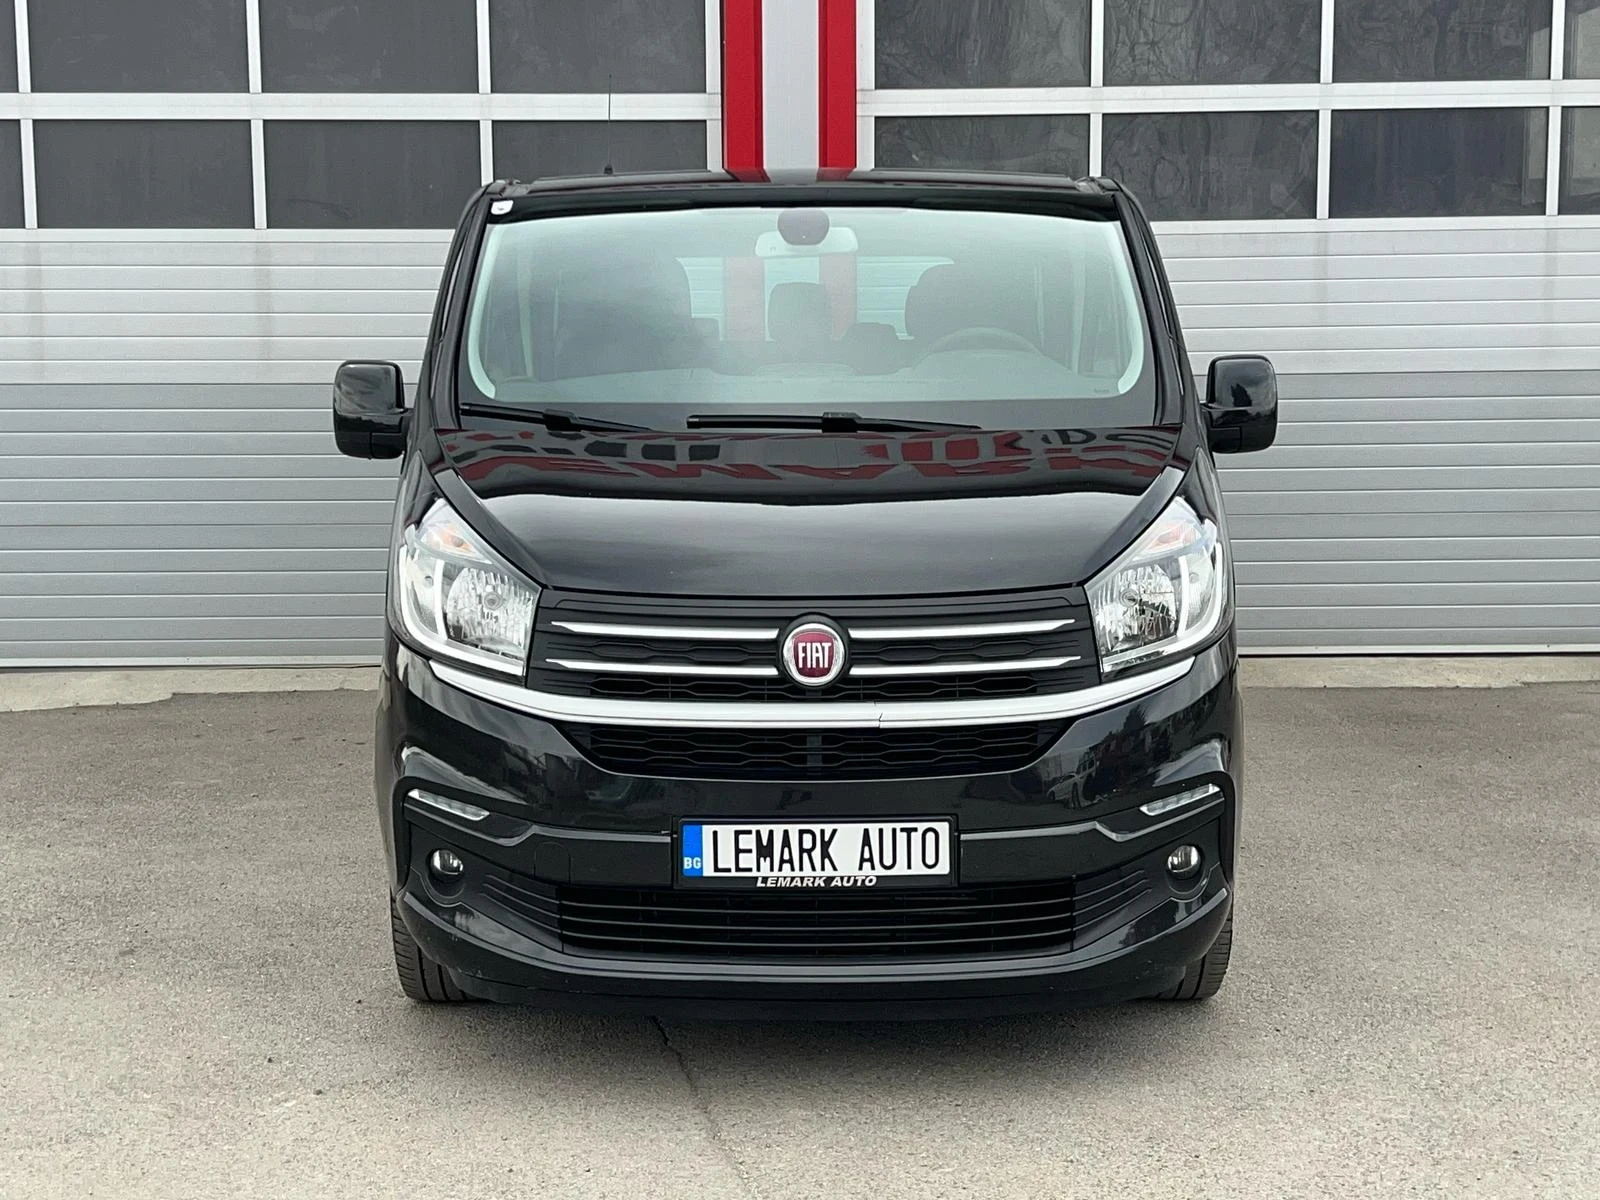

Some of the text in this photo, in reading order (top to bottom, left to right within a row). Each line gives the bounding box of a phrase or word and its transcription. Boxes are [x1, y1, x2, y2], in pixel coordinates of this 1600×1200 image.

[797, 642, 832, 668] FIAT
[712, 826, 940, 873] LEMARK AUTO
[683, 857, 701, 869] BG
[756, 875, 877, 888] LEMARK AUTO
